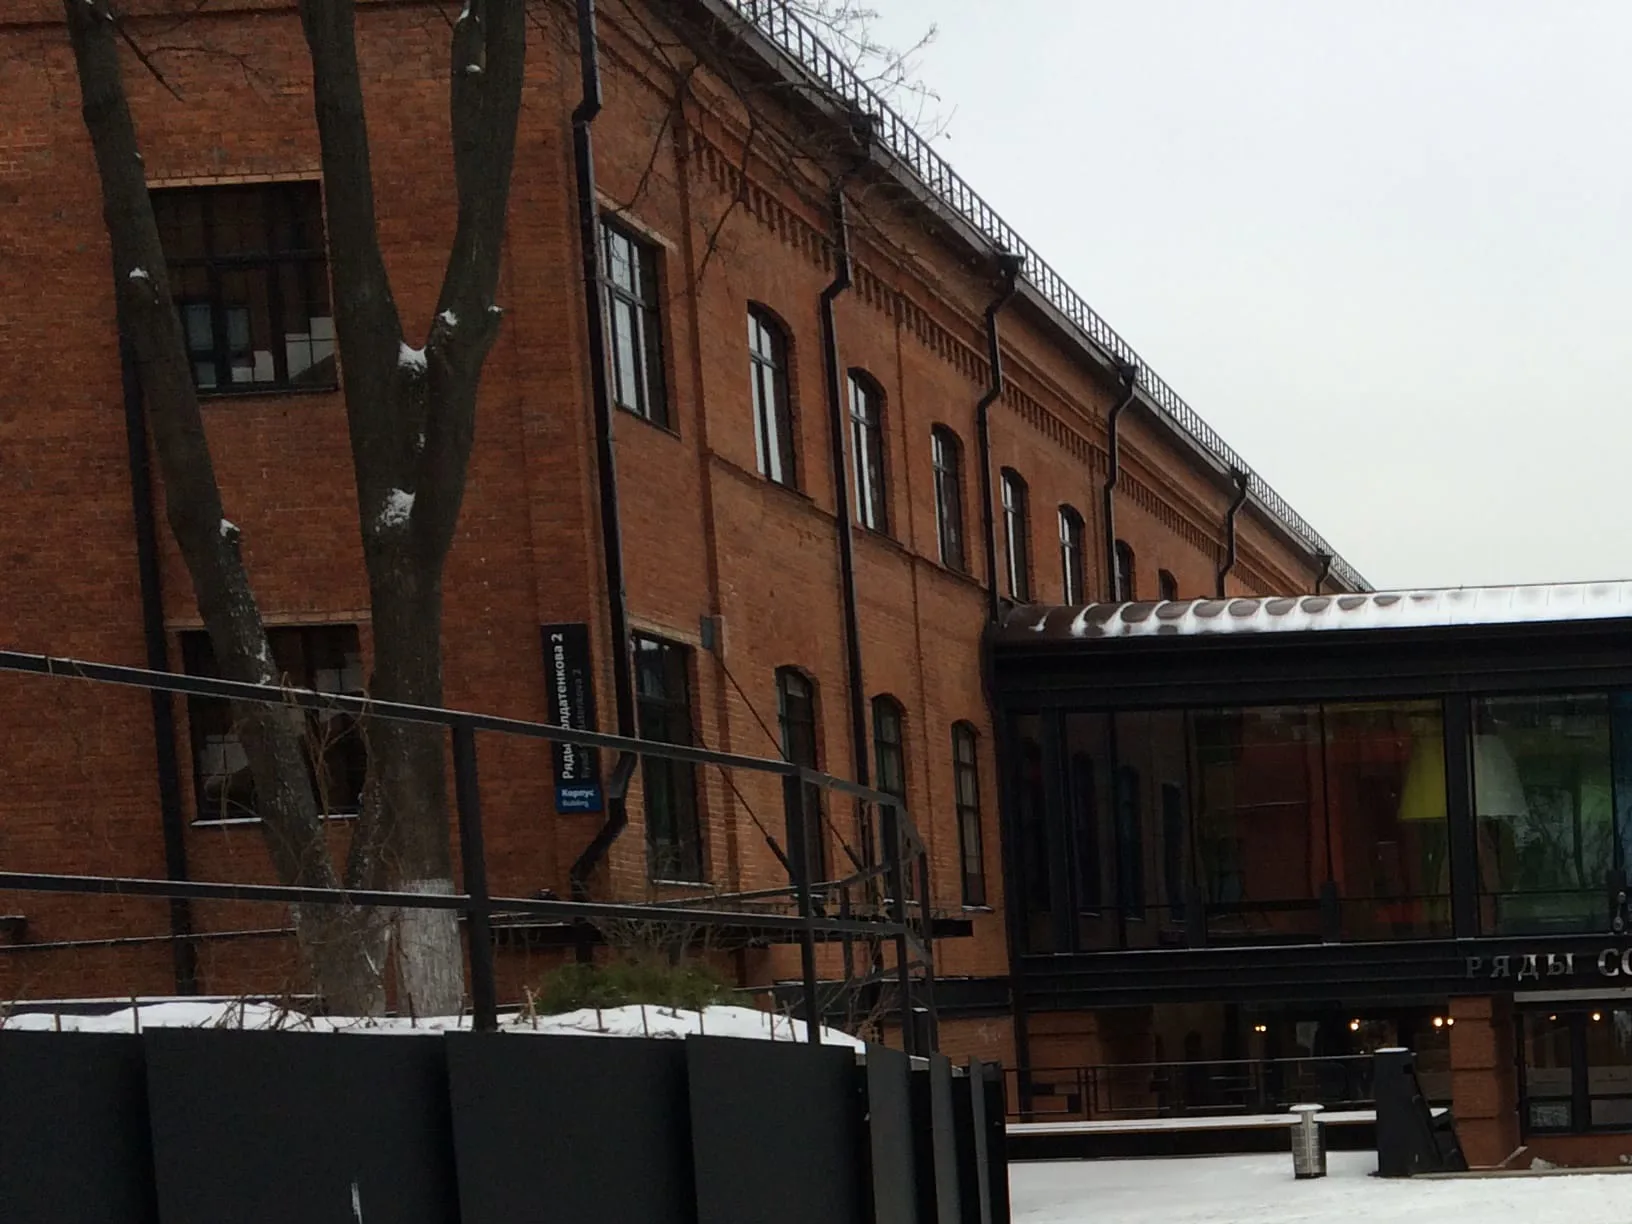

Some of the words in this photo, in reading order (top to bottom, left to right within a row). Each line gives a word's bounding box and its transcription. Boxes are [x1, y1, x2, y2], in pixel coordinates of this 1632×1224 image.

[551, 633, 563, 643] 2
[553, 645, 571, 731] олдатенкова
[562, 743, 575, 779] Ряды
[1465, 953, 1576, 982] РЯДЫ
